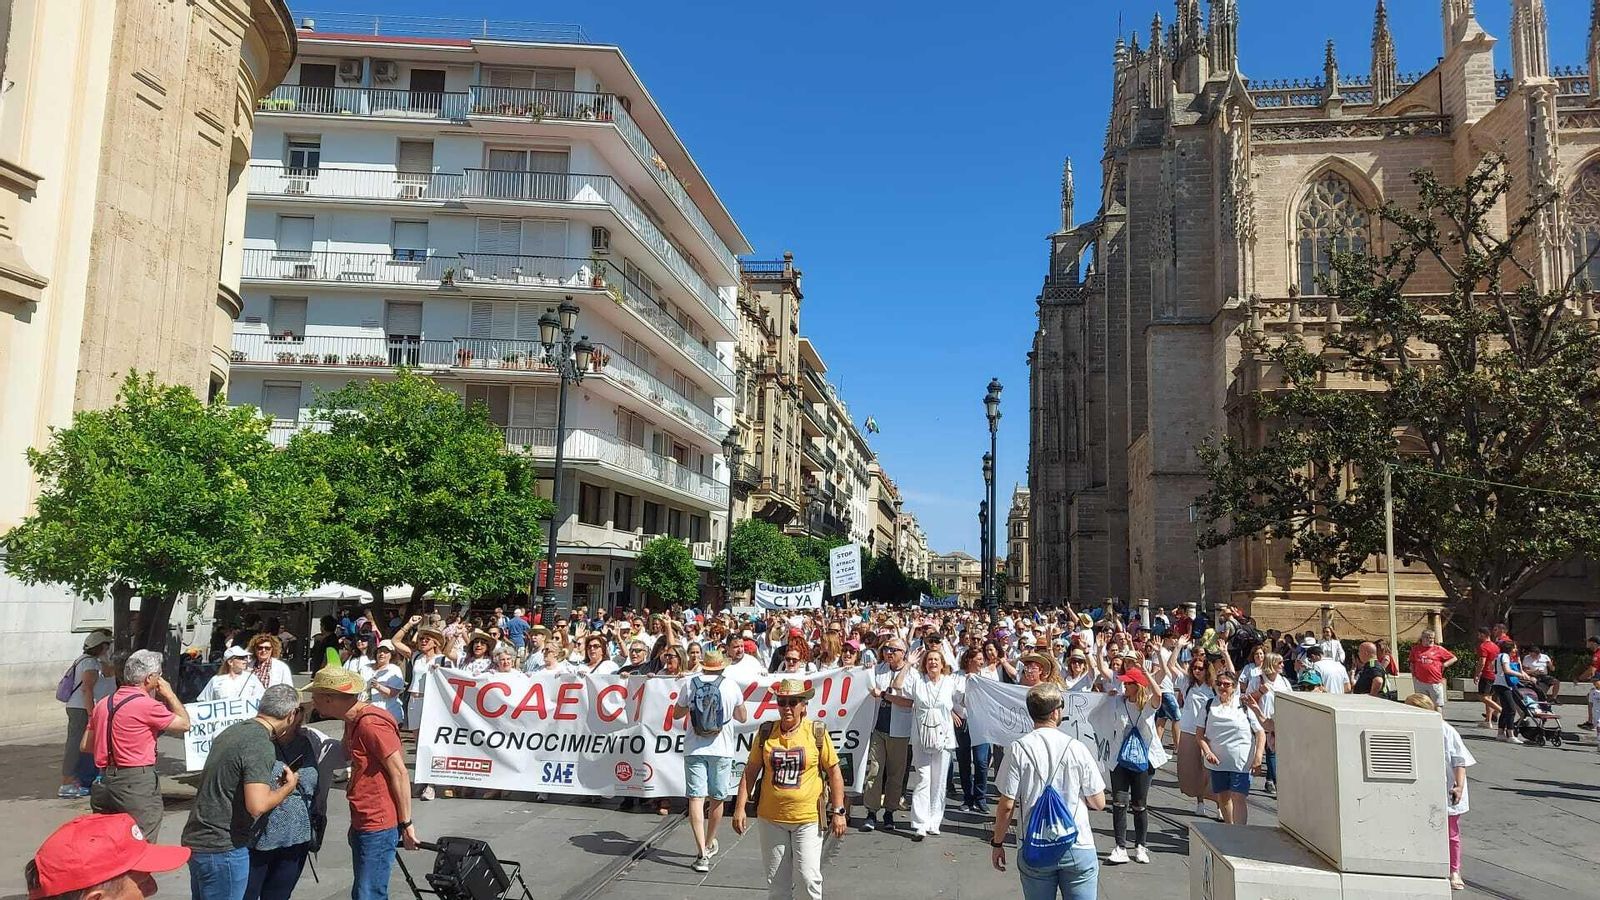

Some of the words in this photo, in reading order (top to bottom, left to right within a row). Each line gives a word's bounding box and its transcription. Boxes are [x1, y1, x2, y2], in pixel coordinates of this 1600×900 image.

[837, 551, 852, 559] STOP
[774, 596, 788, 607] C1
[795, 595, 812, 607] YA
[198, 699, 260, 720] JAEN
[448, 678, 583, 720] TCAE
[597, 683, 645, 722] C1
[189, 723, 206, 738] POR
[434, 726, 645, 754] RECONOCIMIENTO
[542, 762, 575, 783] SAE
